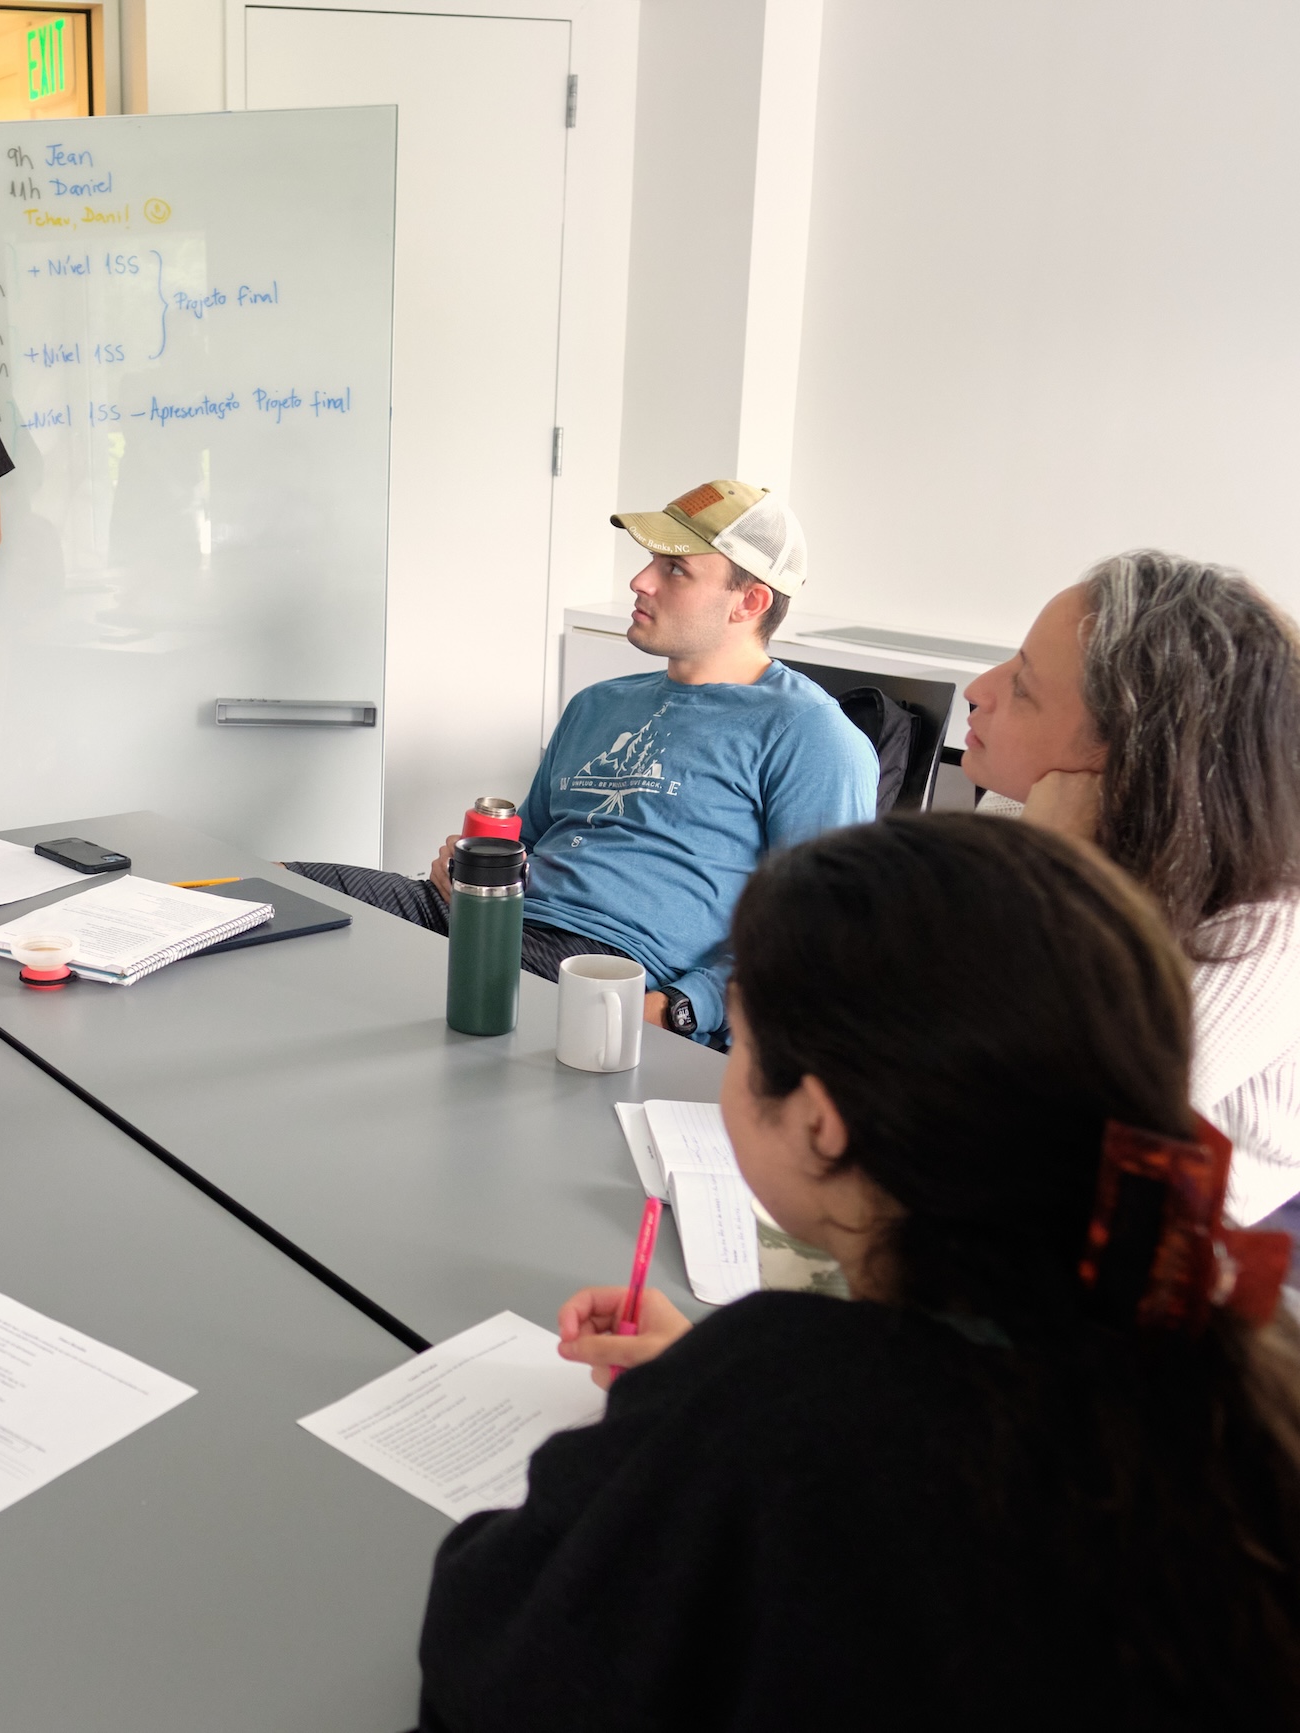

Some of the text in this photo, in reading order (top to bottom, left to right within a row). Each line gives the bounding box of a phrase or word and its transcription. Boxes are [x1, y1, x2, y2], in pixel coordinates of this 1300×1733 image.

[27, 18, 65, 101] EXIT
[7, 143, 94, 169] 9h Jean
[9, 171, 112, 200] 11h Daniel
[173, 287, 227, 319] Projeto
[150, 392, 240, 427] Apresentação
[252, 387, 302, 424] Projeto
[629, 526, 647, 543] Outer
[674, 544, 690, 553] NC
[666, 780, 681, 796] E
[571, 836, 583, 848] S
